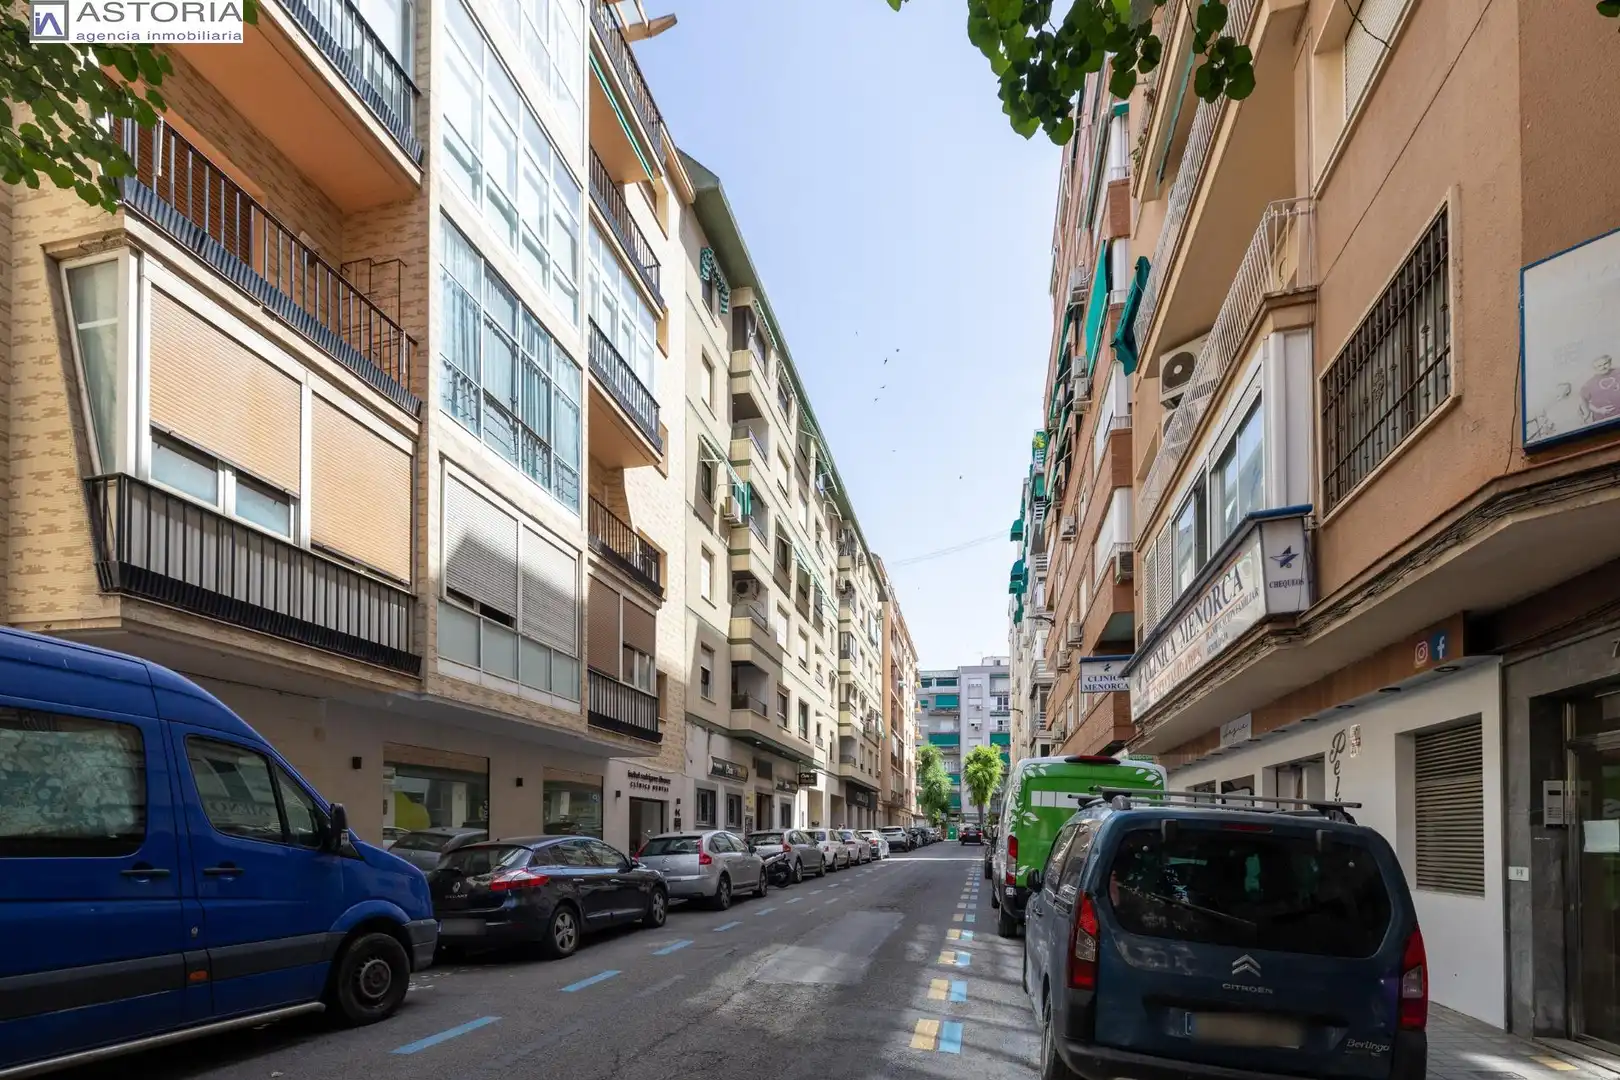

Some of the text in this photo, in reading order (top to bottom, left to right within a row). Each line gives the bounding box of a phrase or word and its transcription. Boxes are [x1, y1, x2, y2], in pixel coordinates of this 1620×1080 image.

[1179, 565, 1244, 649] MENORCA
[1084, 683, 1129, 691] MENORCA
[1329, 728, 1347, 803] Pel
[1346, 1038, 1390, 1052] Berlingo
